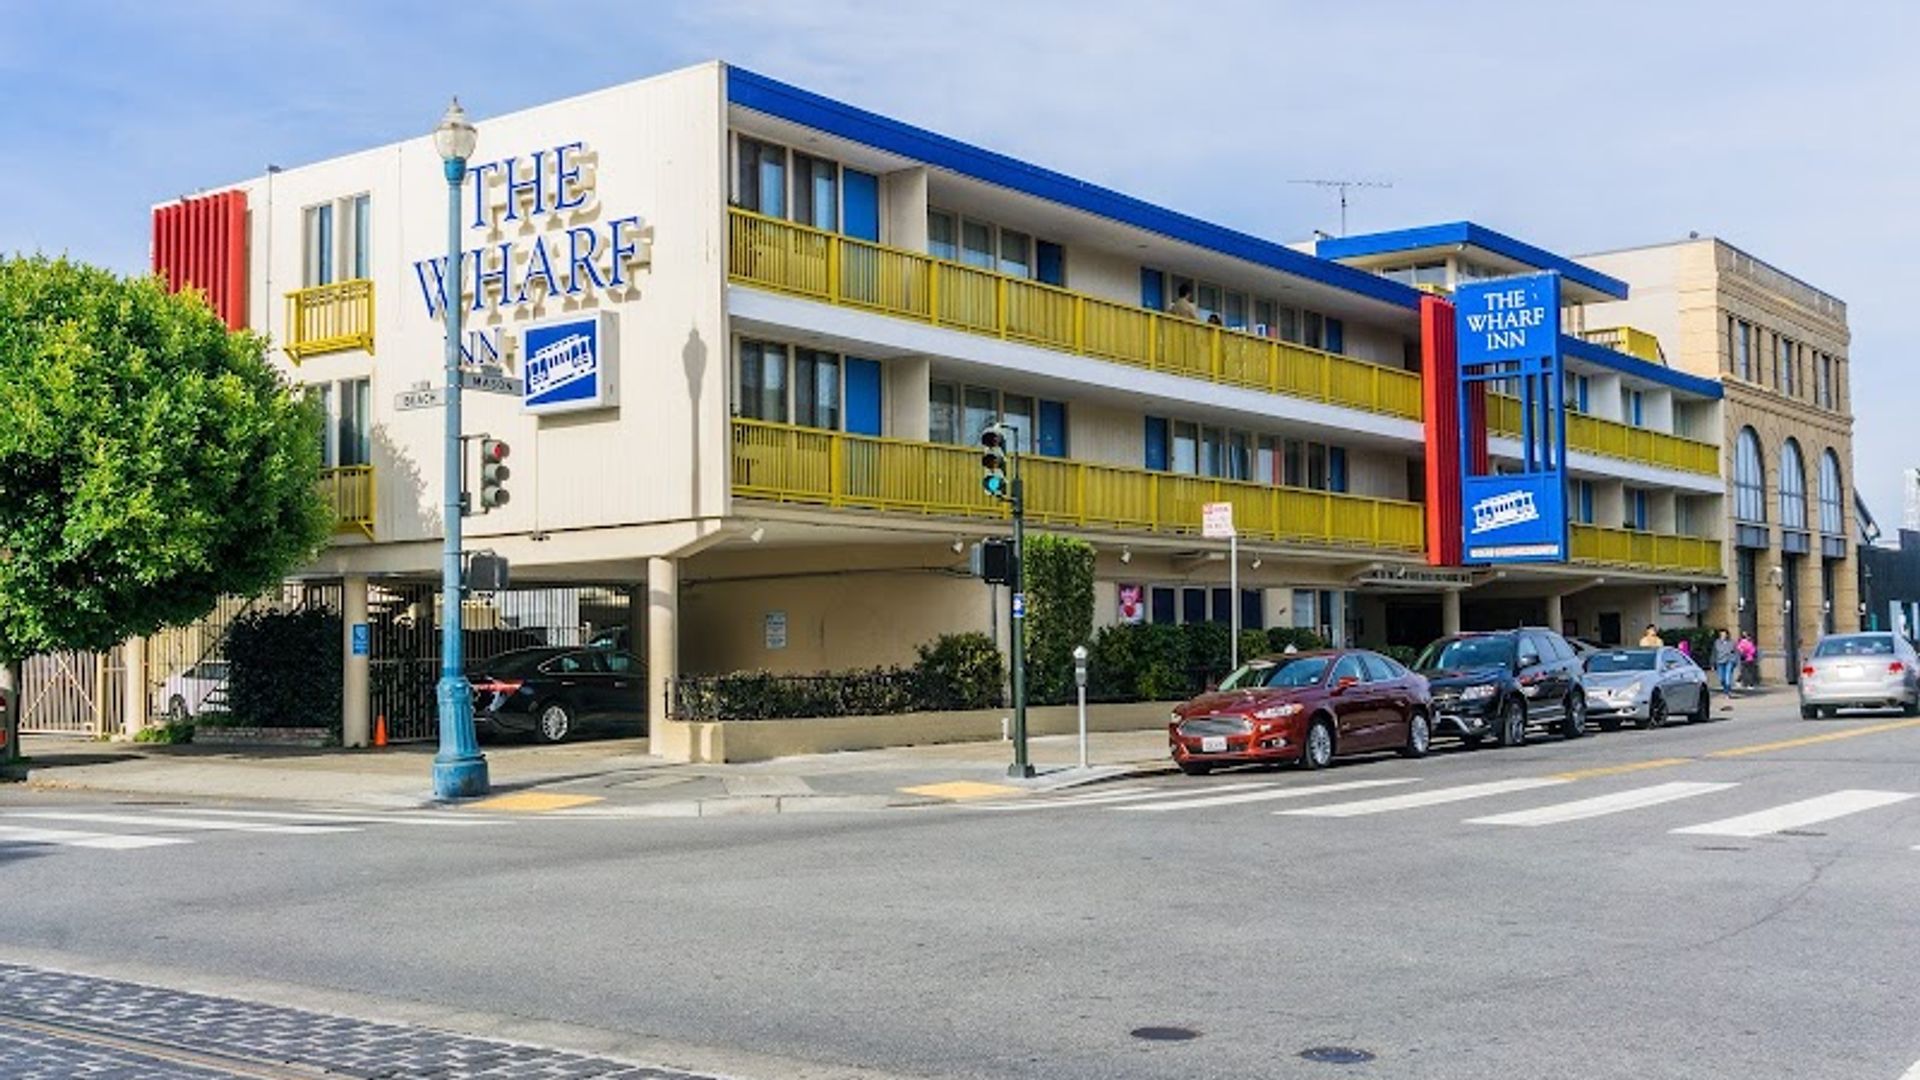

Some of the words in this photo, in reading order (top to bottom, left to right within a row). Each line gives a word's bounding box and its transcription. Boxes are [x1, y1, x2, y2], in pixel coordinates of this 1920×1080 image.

[466, 141, 588, 229] THE
[413, 215, 639, 319] WHARF
[1483, 289, 1526, 311] THE
[1466, 307, 1545, 332] WHARF
[446, 327, 500, 364] NN
[1486, 329, 1526, 350] INN
[472, 376, 513, 391] MASON
